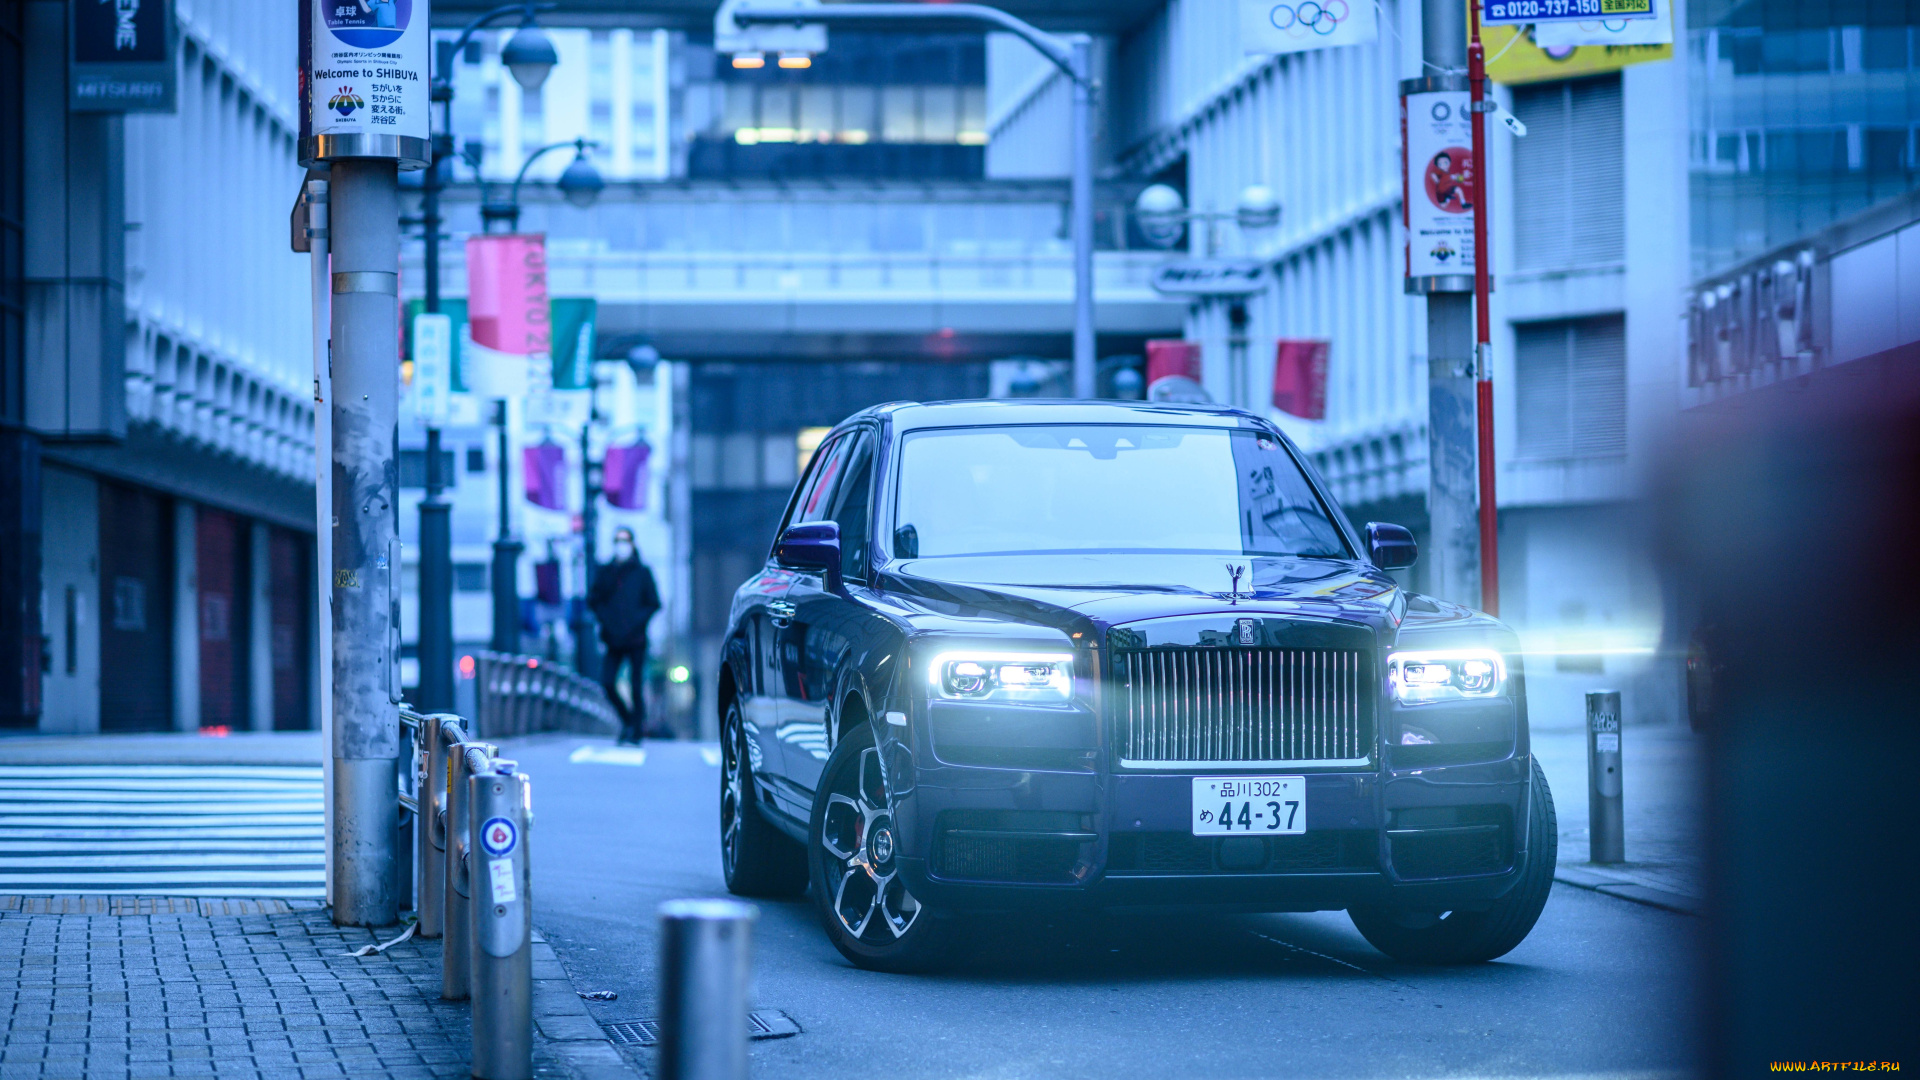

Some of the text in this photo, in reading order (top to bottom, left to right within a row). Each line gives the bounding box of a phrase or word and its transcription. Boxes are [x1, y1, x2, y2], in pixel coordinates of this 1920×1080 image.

[335, 6, 357, 17] 卓球
[1508, 1, 1600, 17] 0120-737-150
[314, 68, 419, 81] Welcome to SHIBUYA
[371, 83, 403, 94] ちがいを
[371, 94, 402, 104] ちからに
[371, 115, 397, 125] 渋谷区
[1200, 801, 1299, 830] め 44-37
